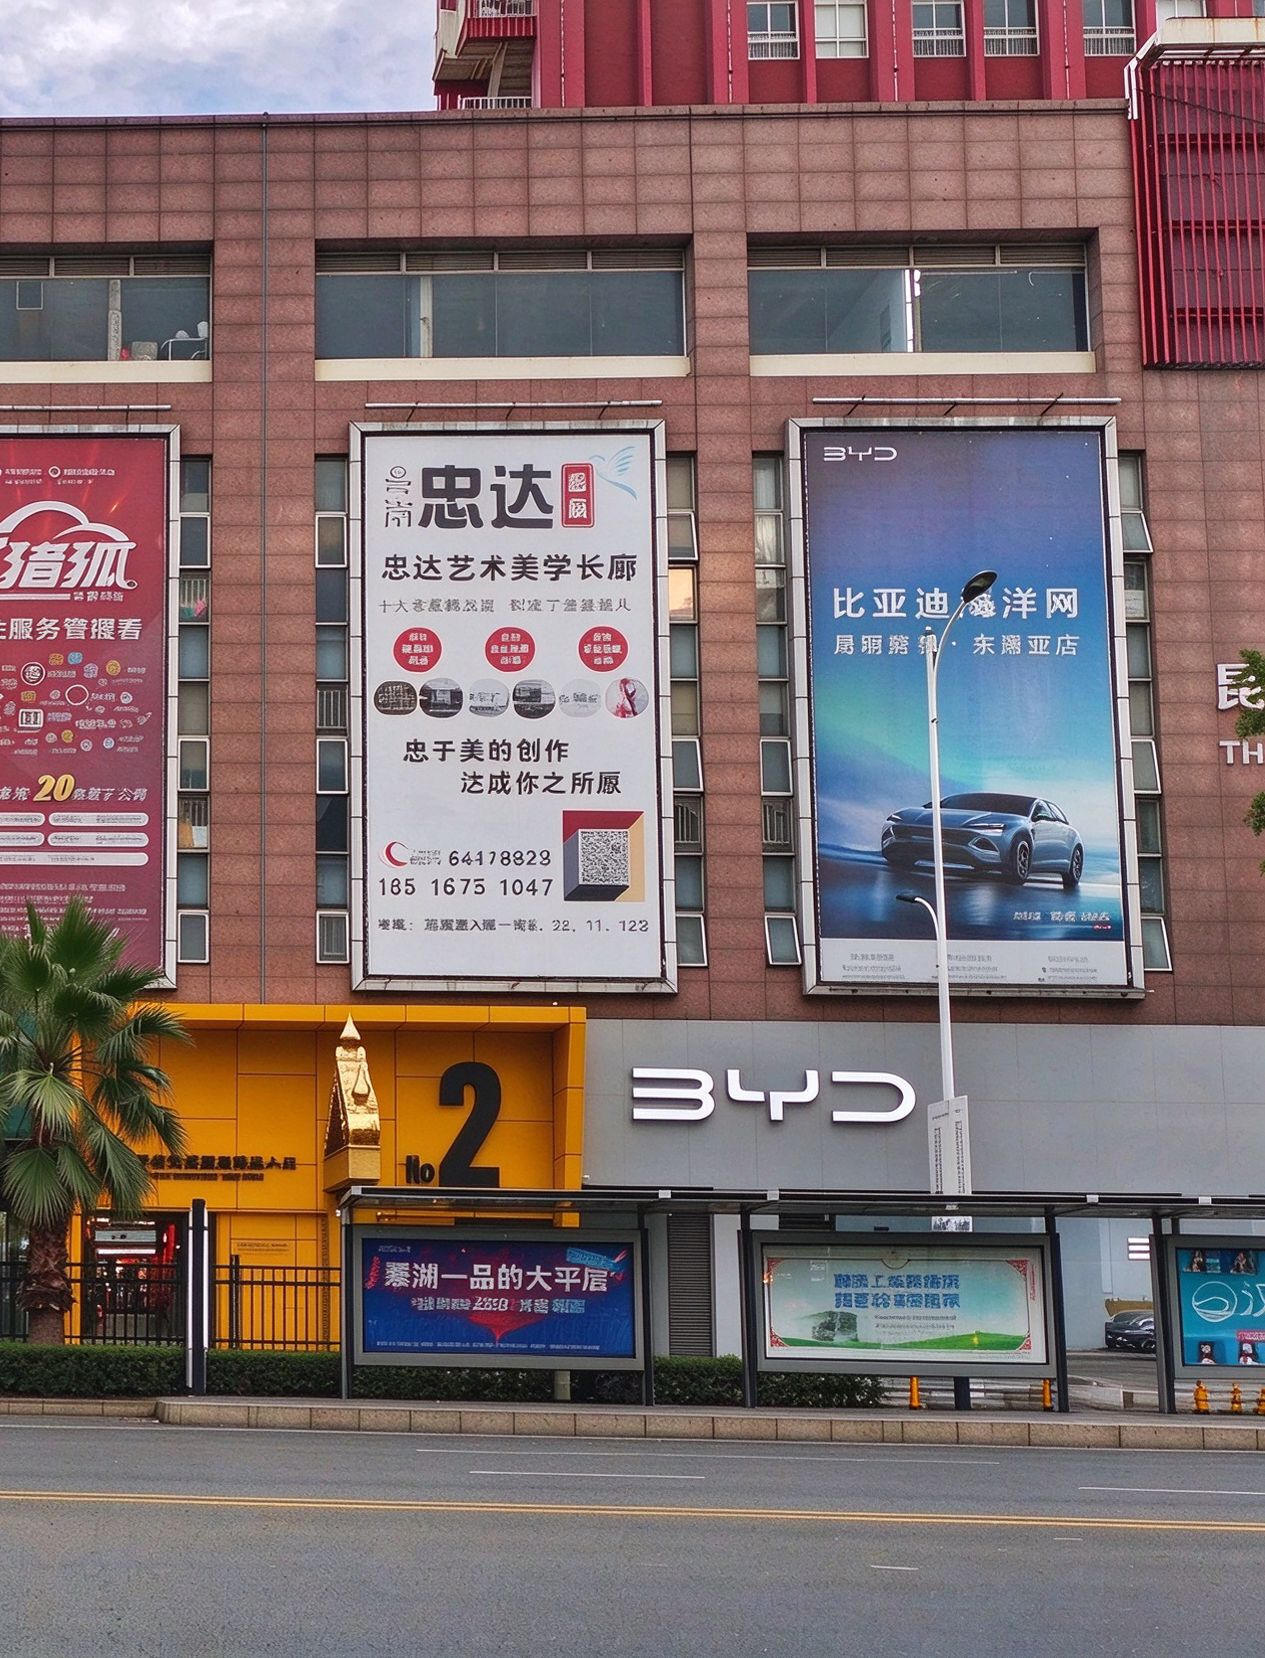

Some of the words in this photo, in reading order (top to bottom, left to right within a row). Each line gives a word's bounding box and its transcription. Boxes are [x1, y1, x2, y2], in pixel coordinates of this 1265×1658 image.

[823, 447, 897, 461] BYD
[418, 464, 554, 529] 忠达
[382, 554, 636, 582] 忠达艺术美学长廊
[403, 738, 569, 763] 忠于美的创作
[461, 771, 621, 796] 达成你之所愿
[632, 1066, 917, 1123] BYD
[438, 1061, 502, 1188] 2
